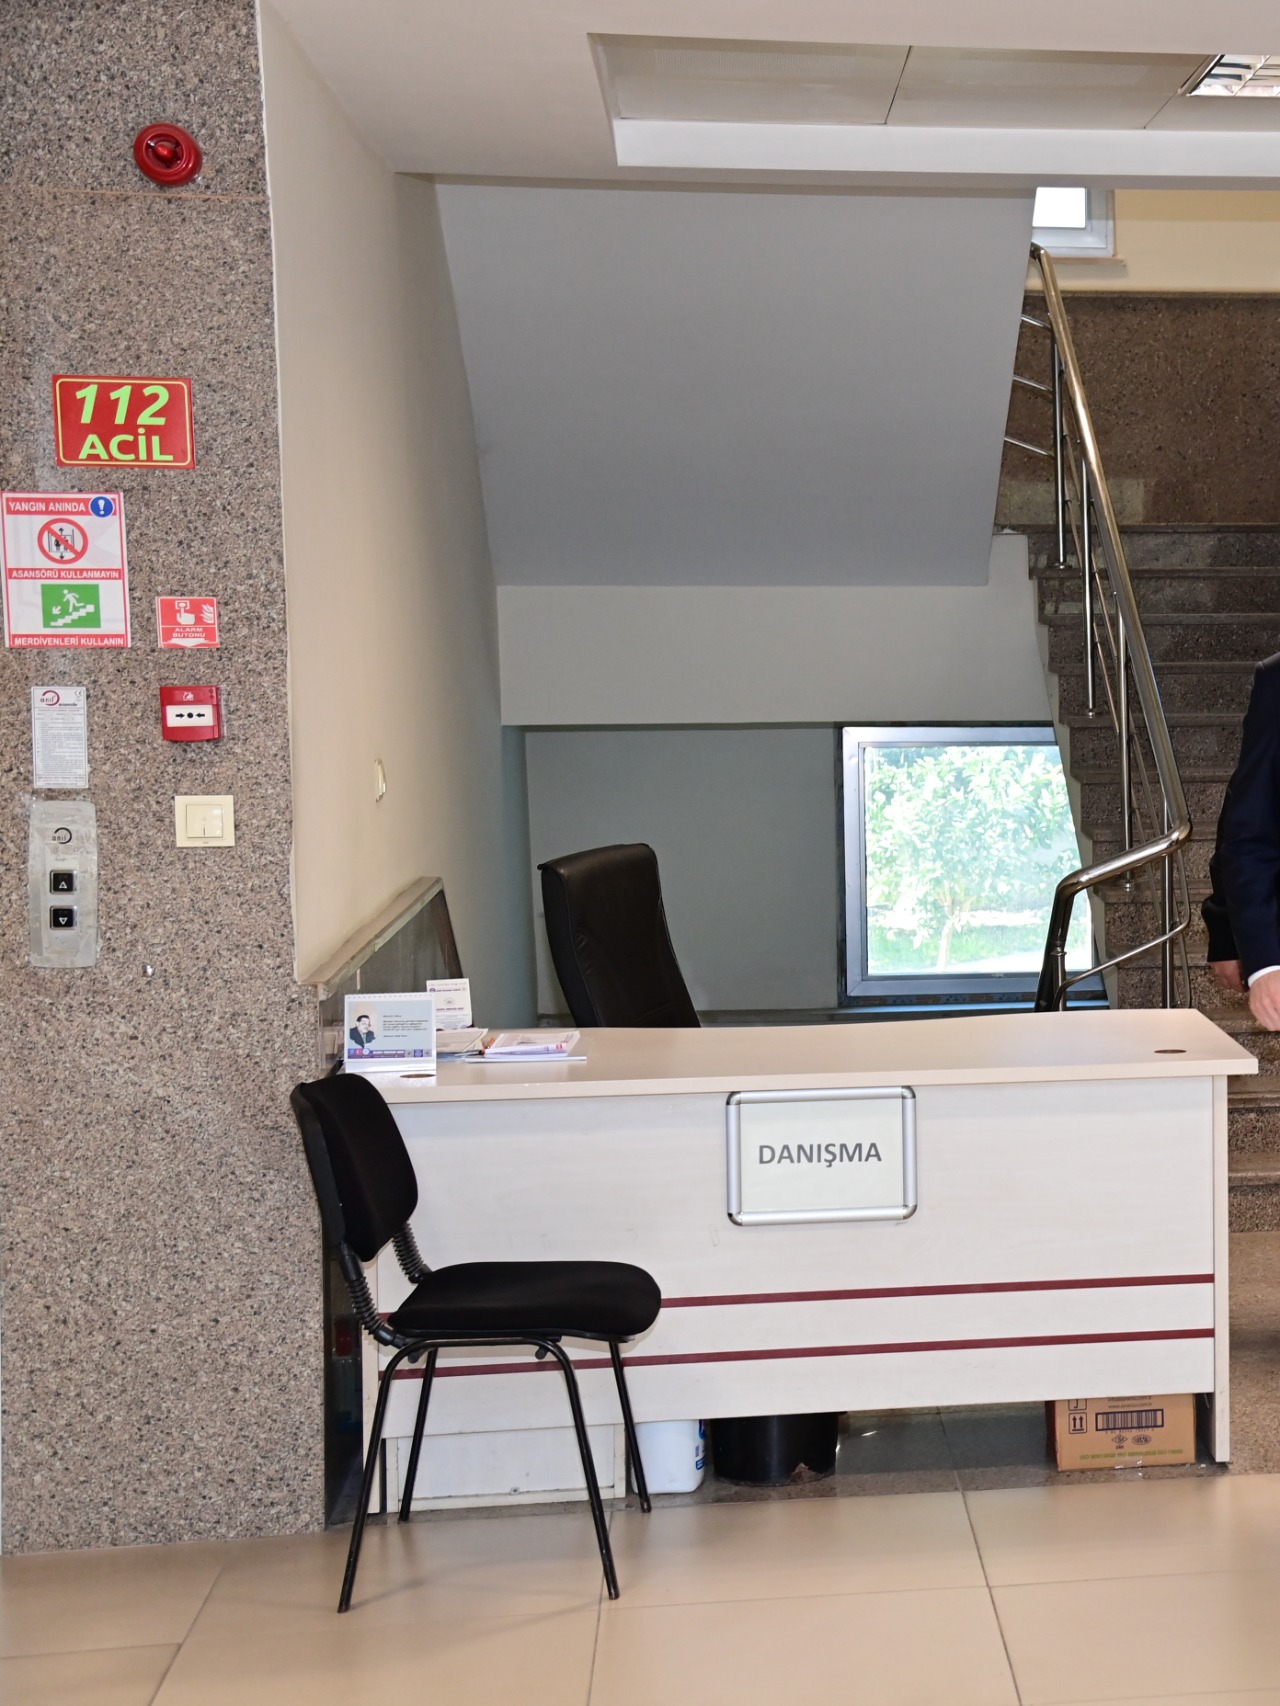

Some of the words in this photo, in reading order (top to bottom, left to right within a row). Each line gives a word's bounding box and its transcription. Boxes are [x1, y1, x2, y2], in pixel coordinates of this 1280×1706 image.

[75, 384, 170, 426] 112
[78, 428, 174, 461] ACİL
[9, 500, 47, 512] YANGIN
[49, 499, 86, 512] ANINDA
[11, 568, 59, 579] ASANSÖRÜ
[60, 569, 119, 579] KULLANMAYIN
[14, 635, 79, 646] MERDİVENLERİ
[80, 637, 124, 646] KULLANIN
[758, 1142, 882, 1168] DANIŞMA
